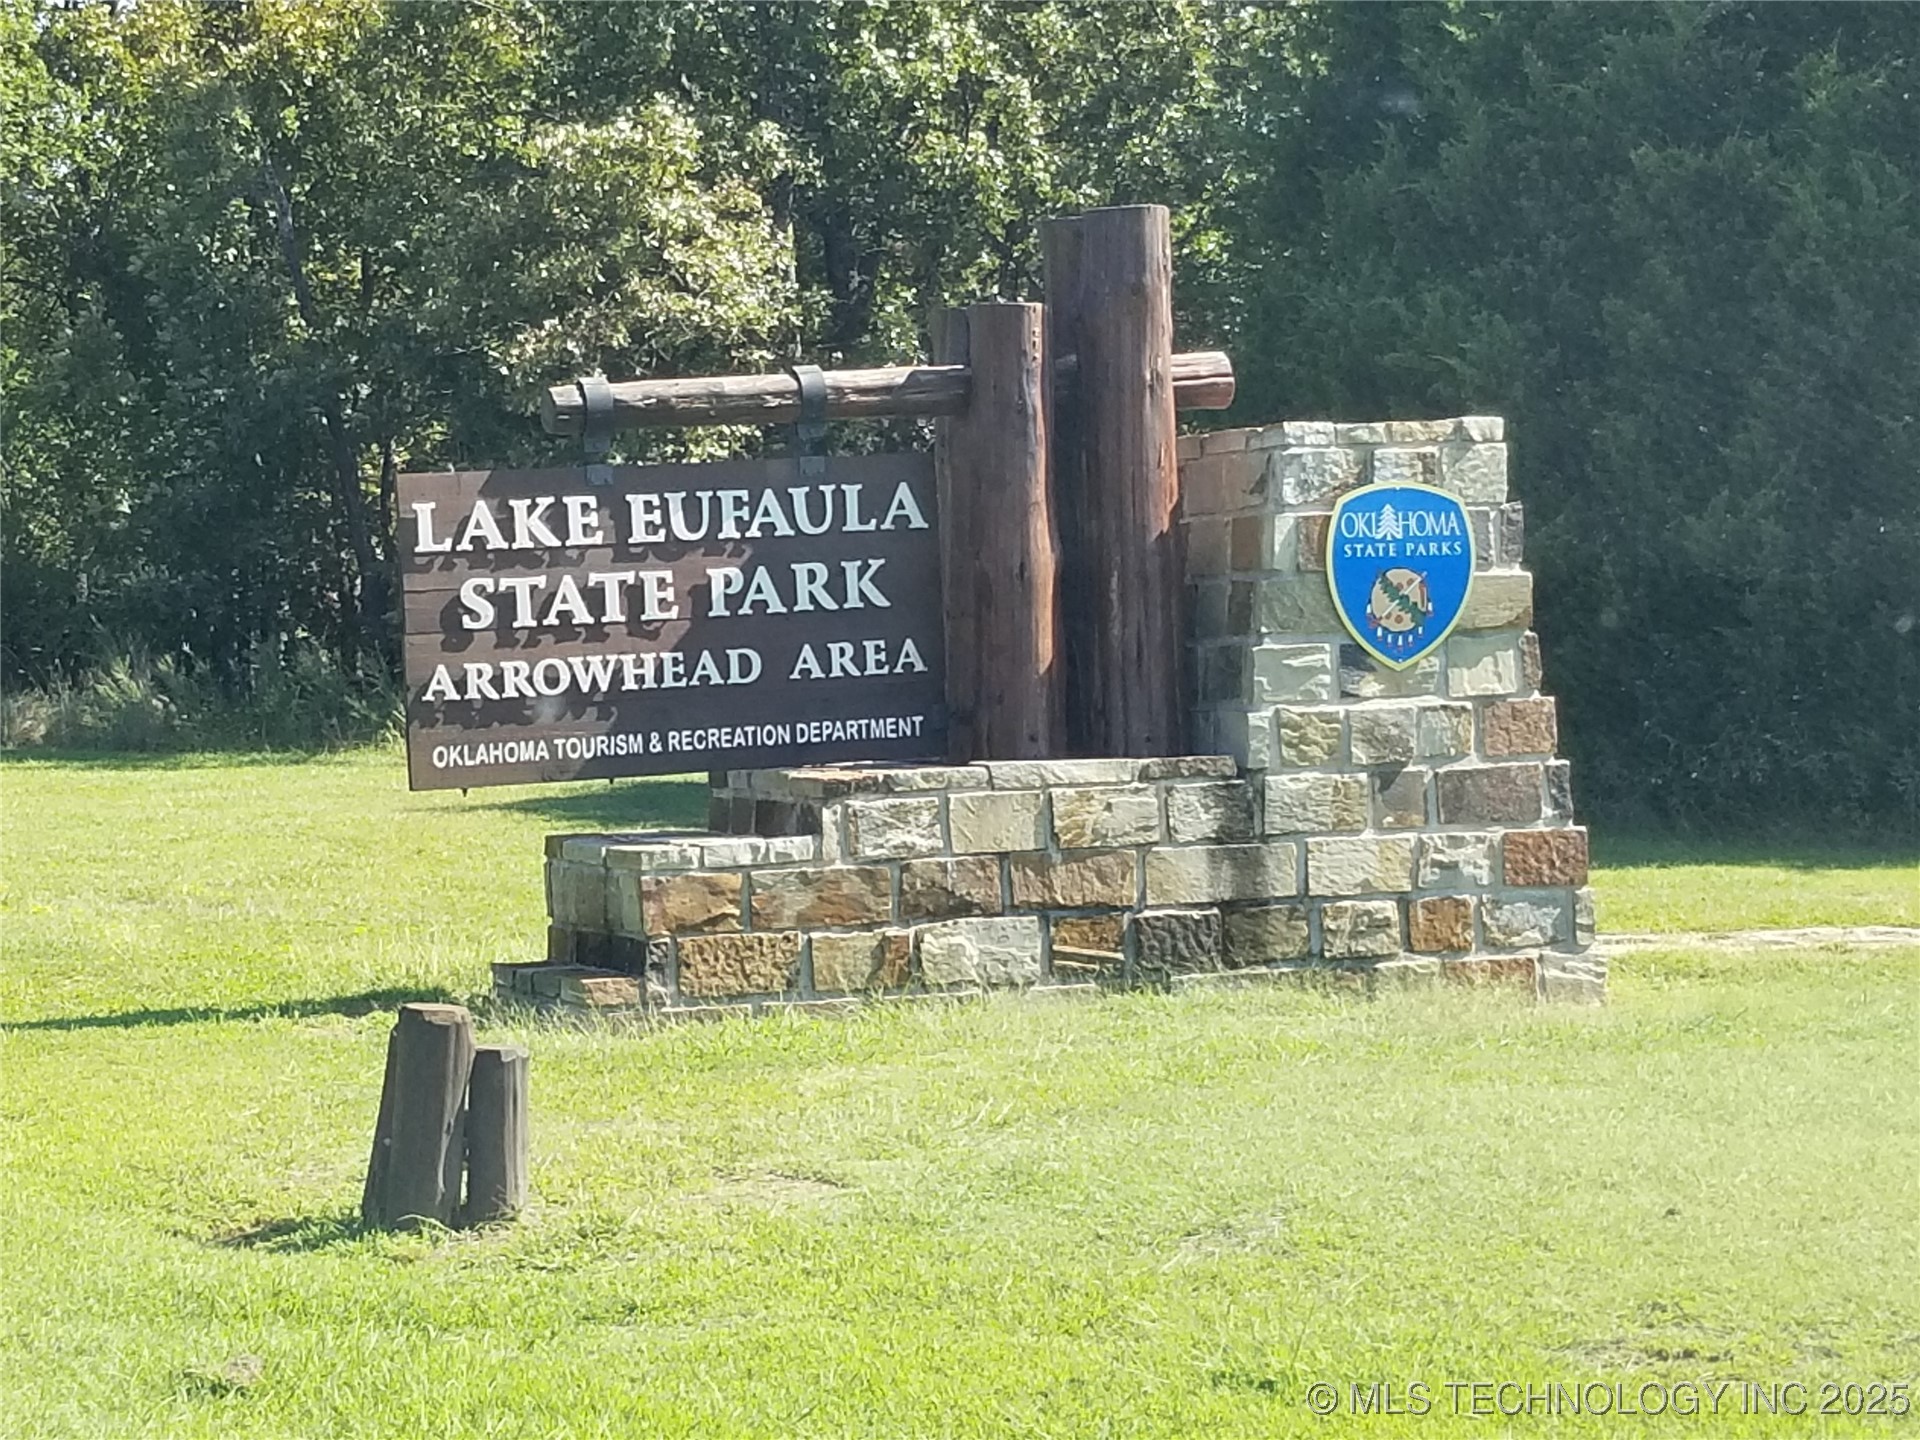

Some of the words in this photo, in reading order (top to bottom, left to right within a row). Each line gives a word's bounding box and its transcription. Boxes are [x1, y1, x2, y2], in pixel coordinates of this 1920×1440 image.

[411, 494, 603, 553] LAKE
[625, 481, 929, 545] EUFAULA
[1343, 543, 1396, 558] STATE
[1405, 541, 1462, 556] PARKS
[460, 569, 679, 631] STATE
[705, 558, 892, 618] PARK
[421, 648, 762, 702] ARROWHEAD
[789, 637, 928, 680] AREA
[432, 740, 549, 768] OKLAHOMA
[554, 733, 644, 759] TOURISM
[649, 732, 662, 753] &
[668, 724, 792, 751] RECREATION
[796, 715, 923, 744] DEPARTMENT
